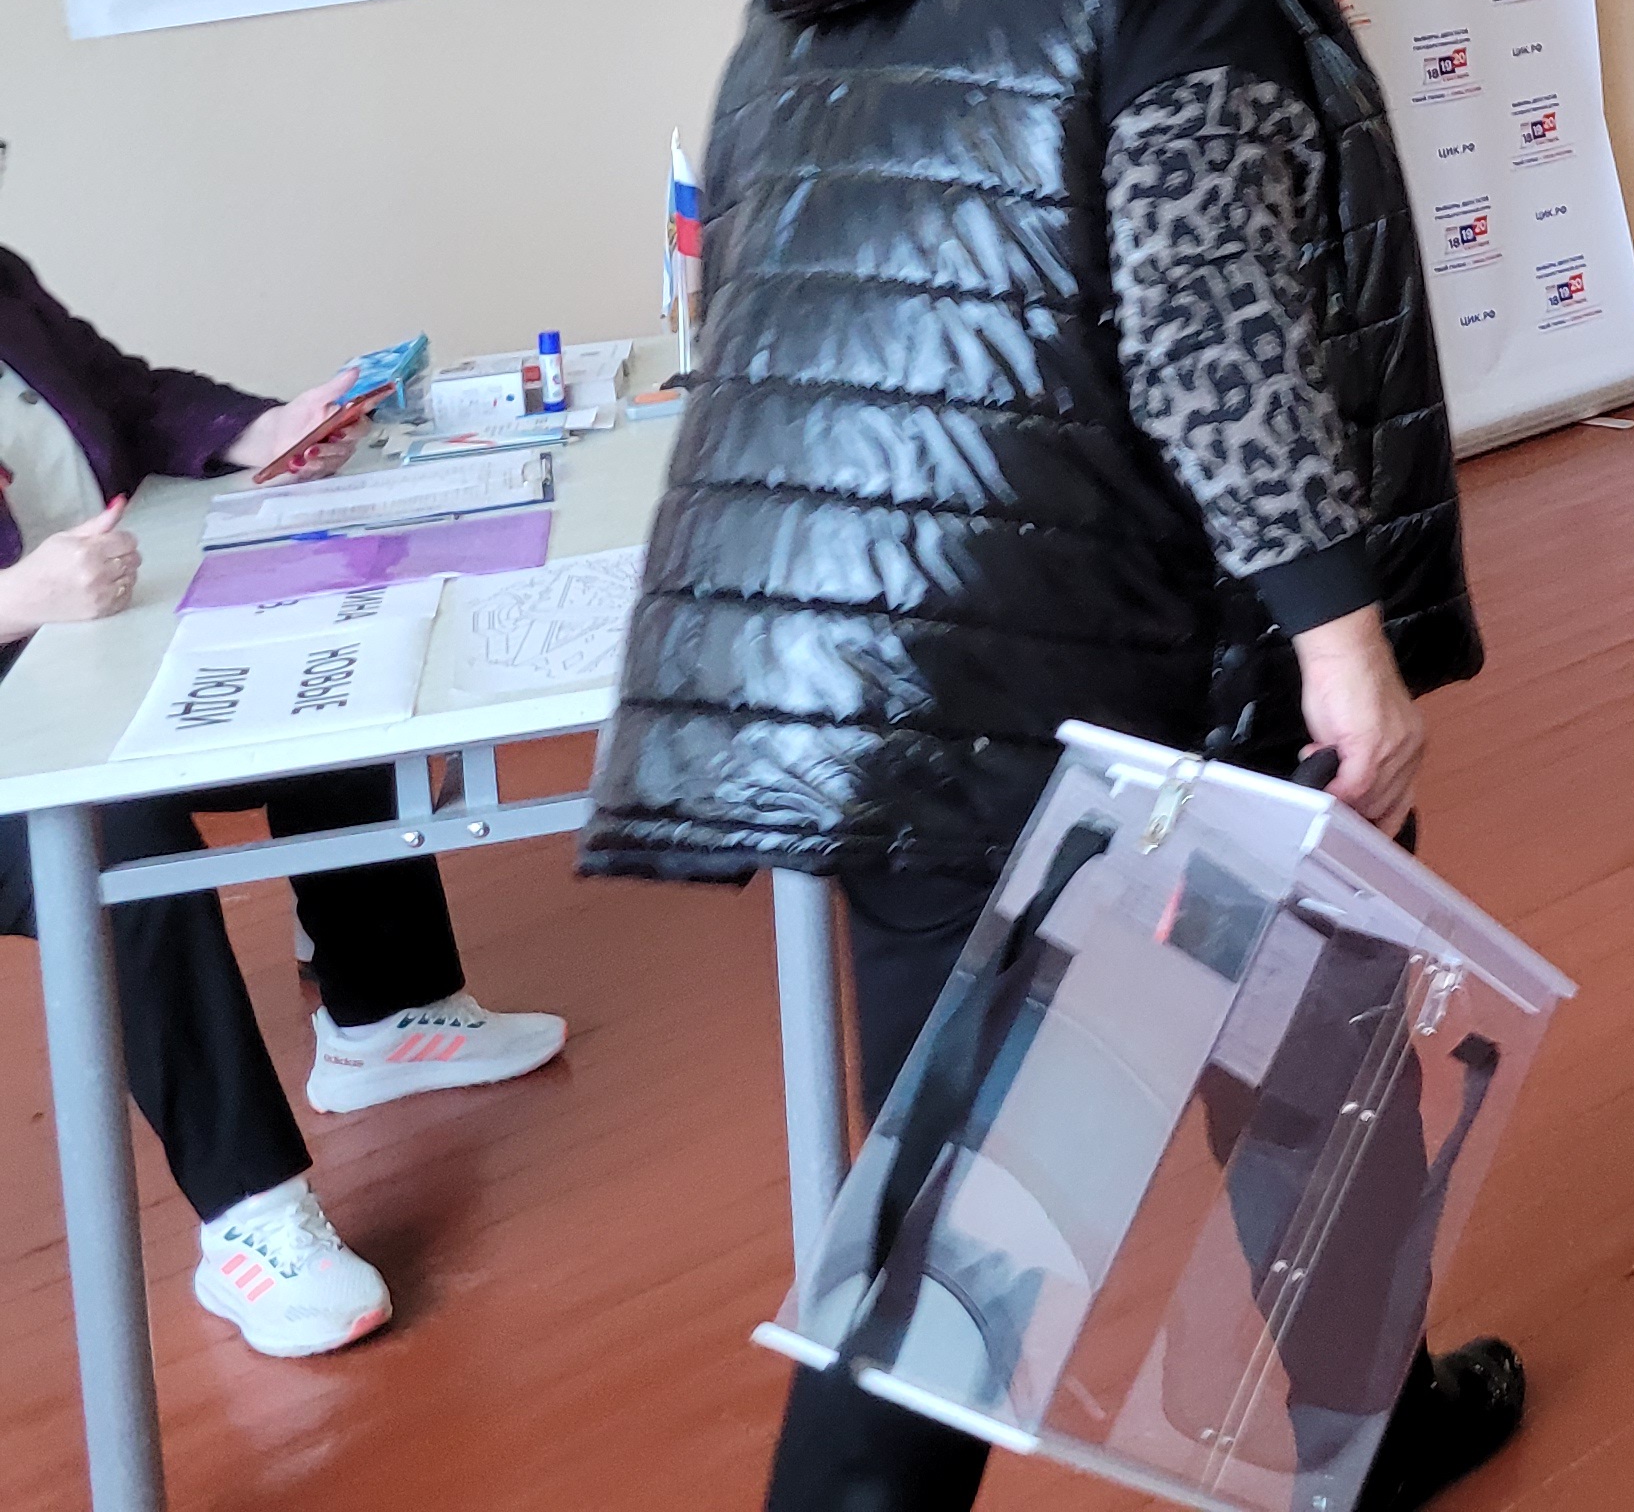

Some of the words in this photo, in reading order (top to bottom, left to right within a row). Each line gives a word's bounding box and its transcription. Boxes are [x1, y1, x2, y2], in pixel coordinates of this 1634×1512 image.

[334, 586, 388, 624] ИНА
[166, 666, 250, 730] ЛЮДИ
[291, 642, 361, 715] НОВЫЕ
